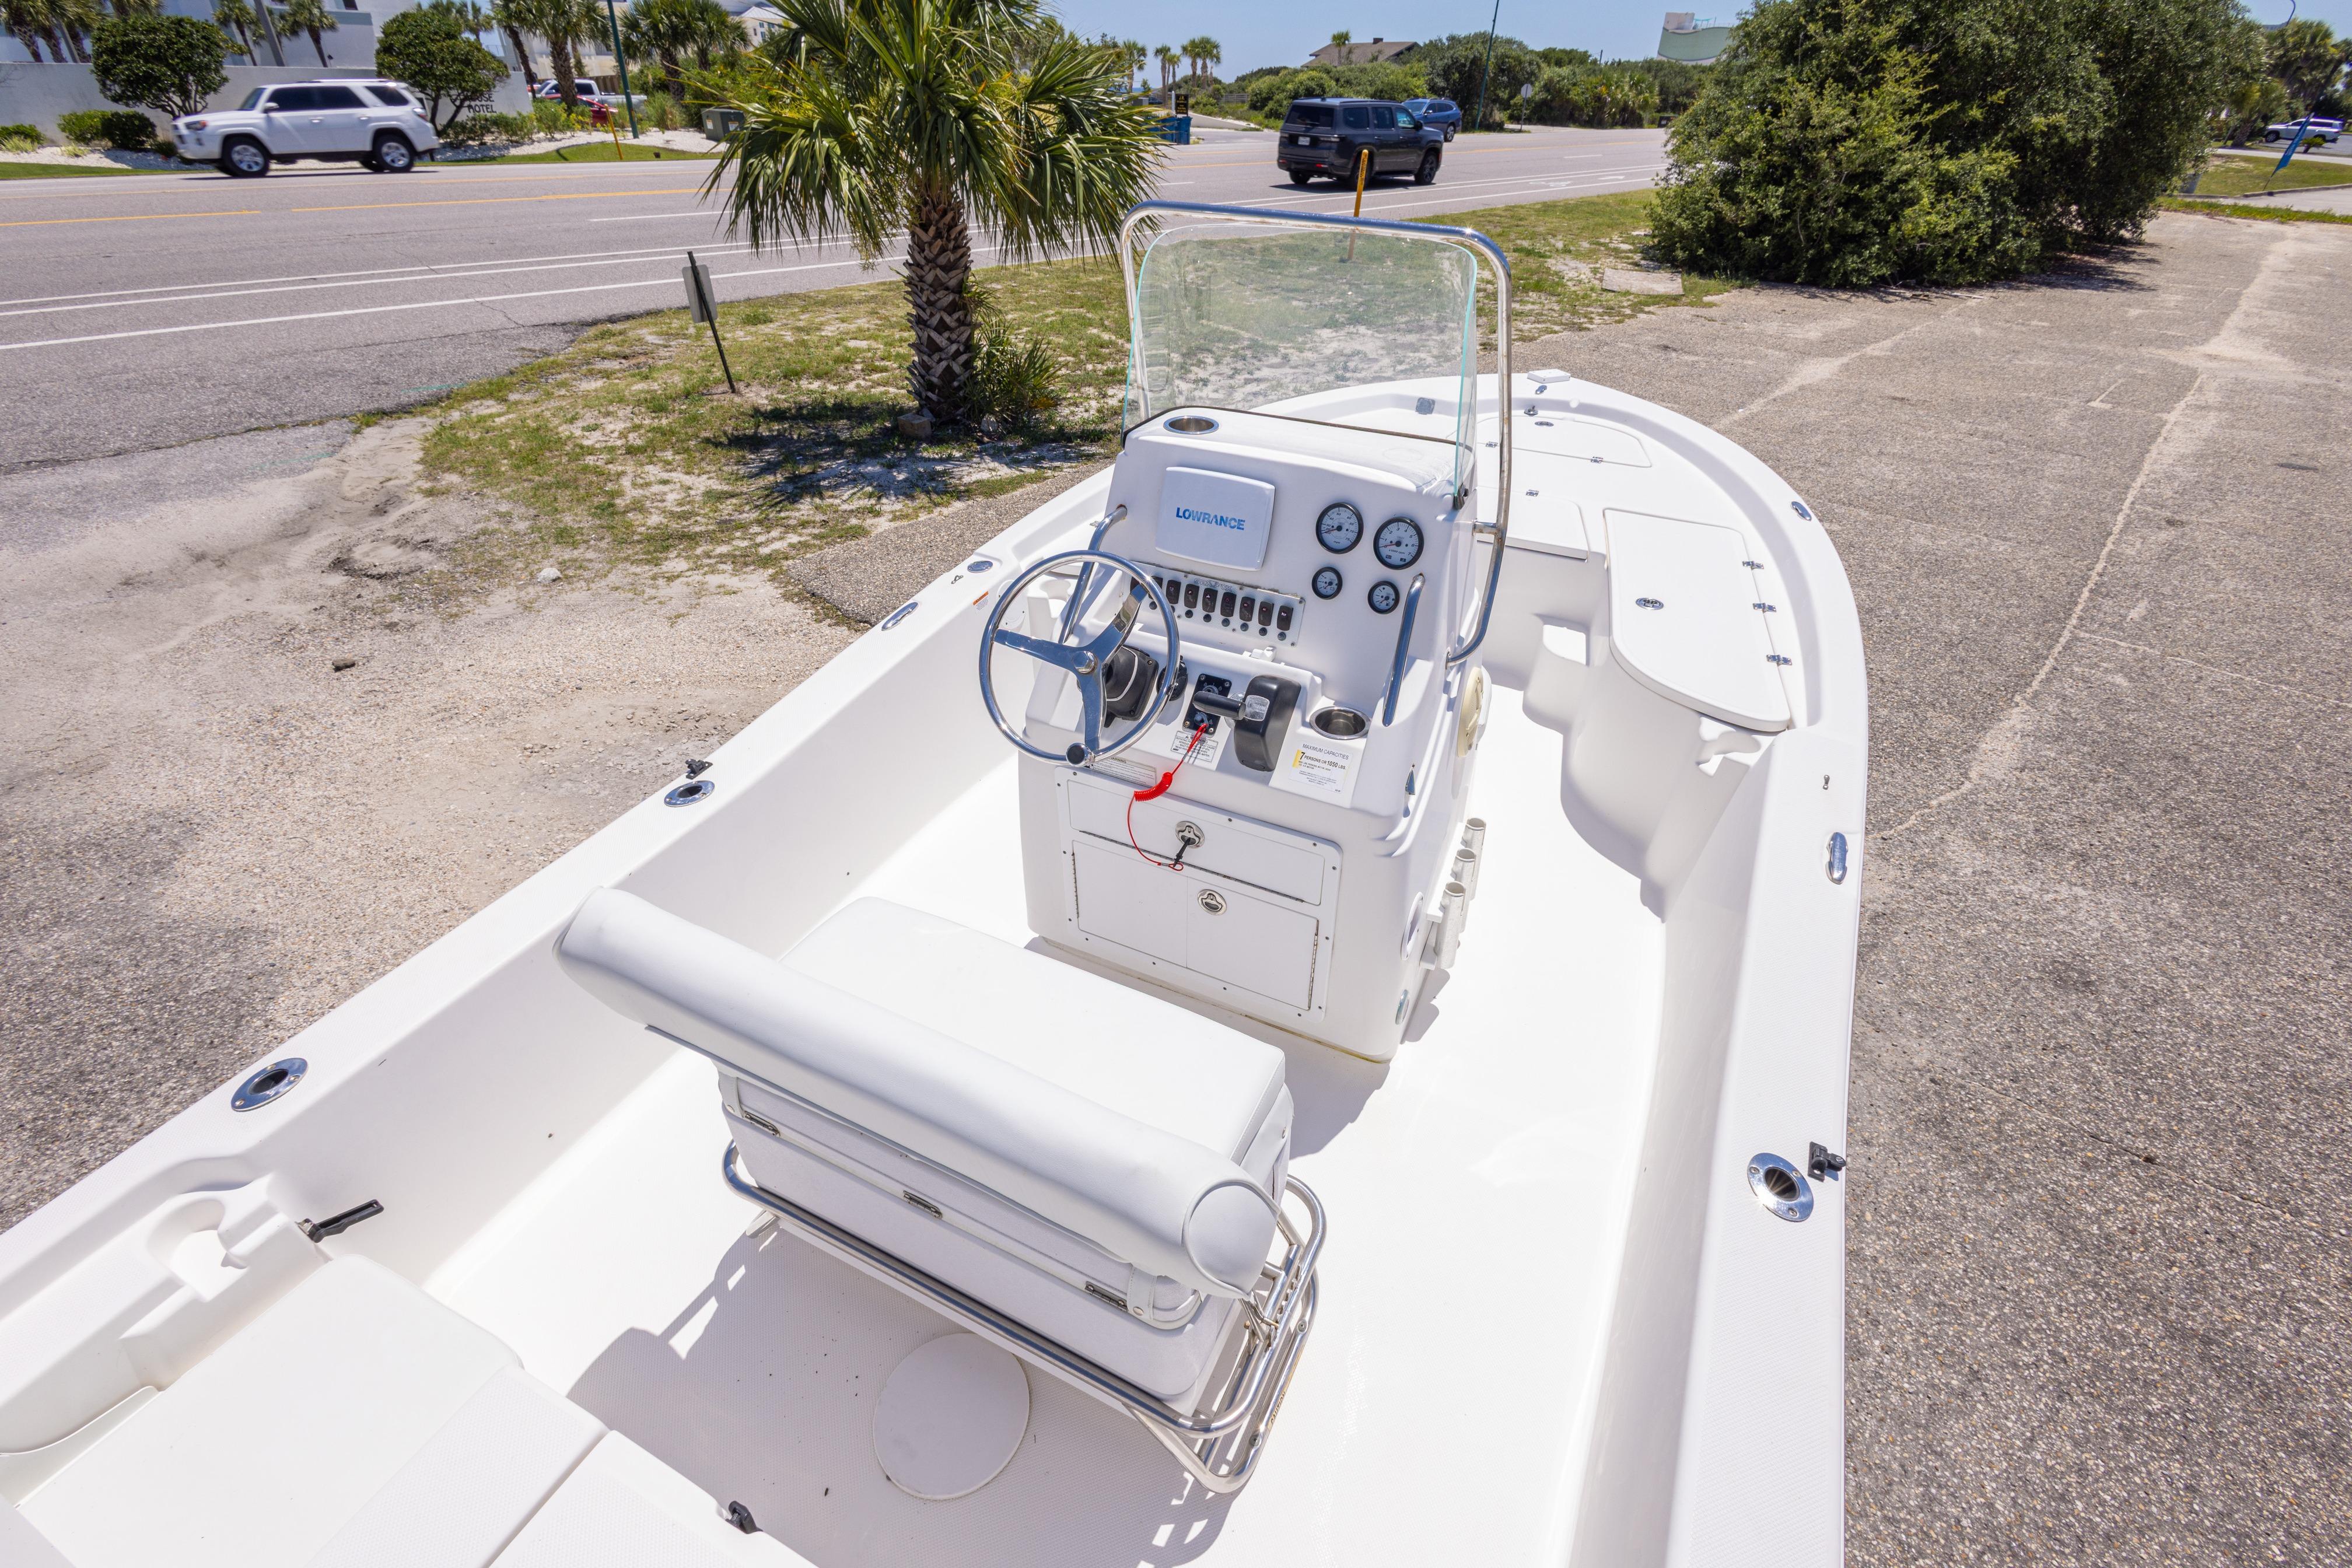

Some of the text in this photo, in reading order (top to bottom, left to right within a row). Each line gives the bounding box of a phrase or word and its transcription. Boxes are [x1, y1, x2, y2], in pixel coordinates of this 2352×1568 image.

[467, 104, 496, 113] HOTEL
[1176, 508, 1245, 530] LOWRANCE
[1190, 735, 1208, 743] WNING
[1303, 744, 1349, 760] MAXIMUM CAPACITIES
[1304, 755, 1321, 763] PERSONS
